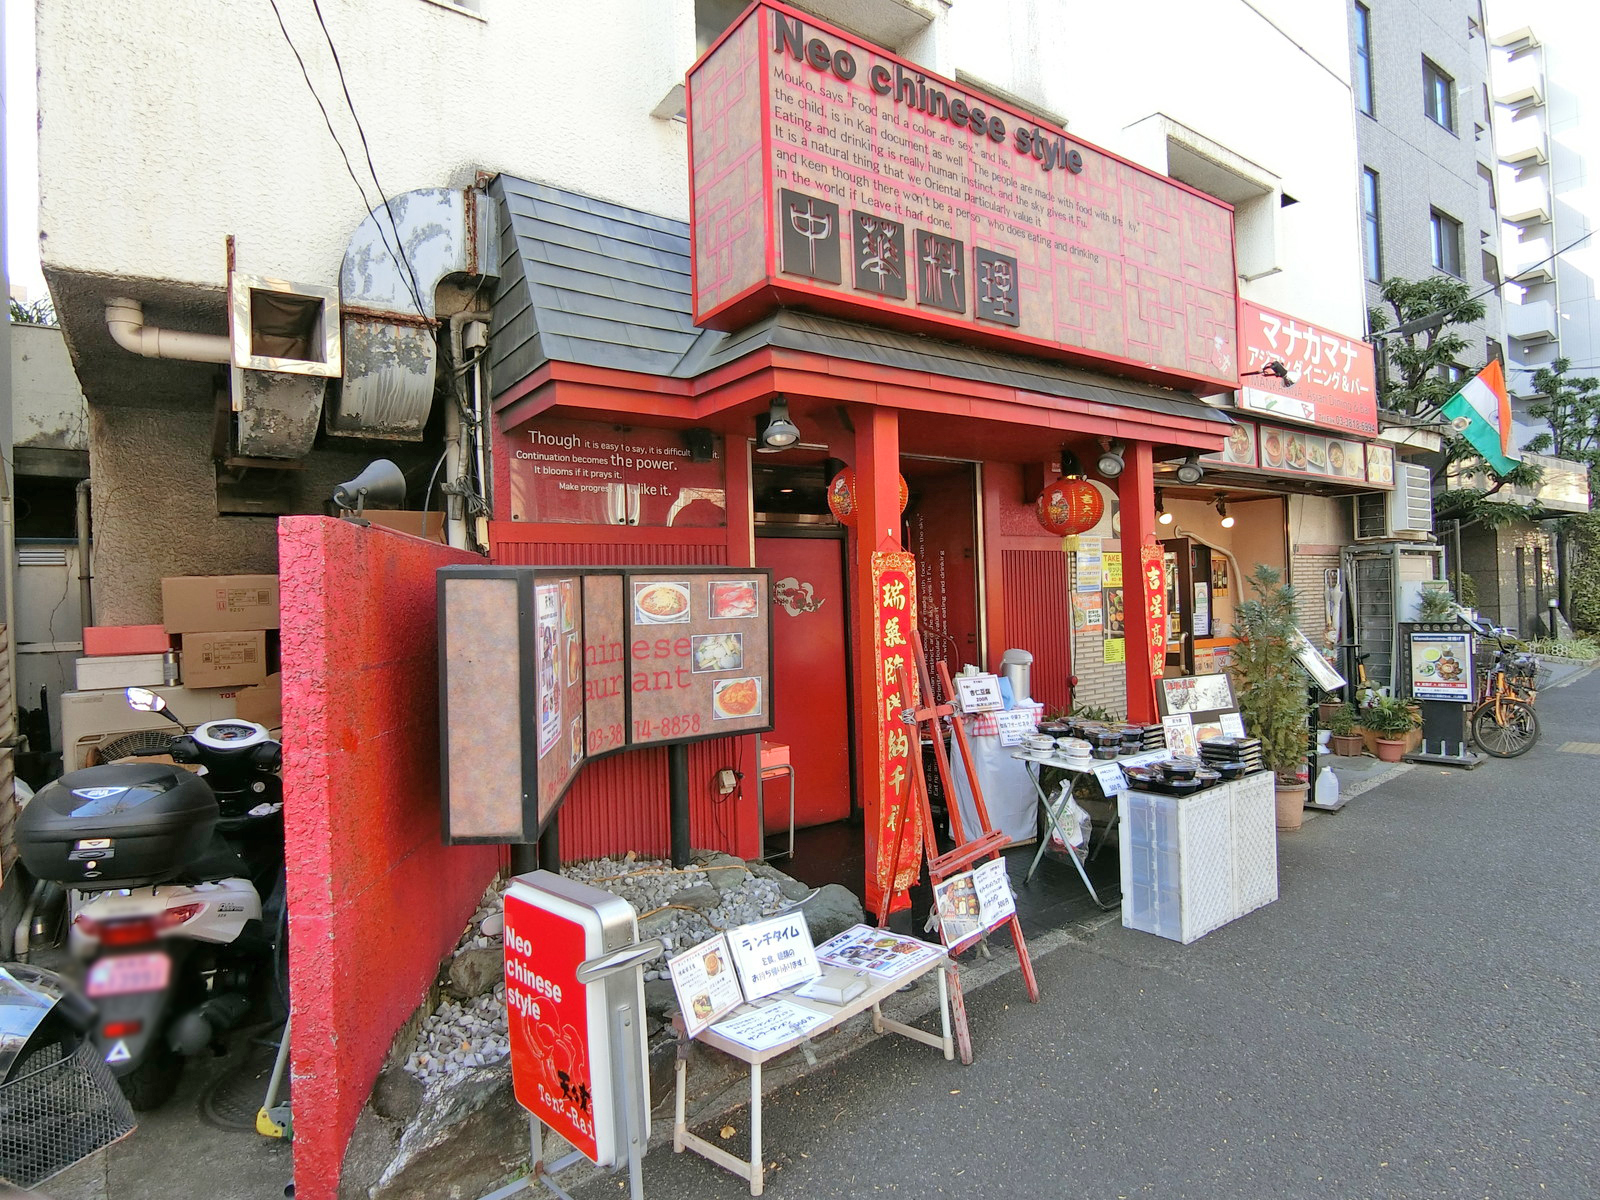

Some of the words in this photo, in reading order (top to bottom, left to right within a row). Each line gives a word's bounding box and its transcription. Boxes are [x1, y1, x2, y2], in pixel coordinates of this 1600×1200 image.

[772, 10, 857, 81] Neo
[867, 63, 1007, 143] chinese
[1013, 127, 1083, 175] style
[773, 66, 816, 94] Mouko,
[819, 86, 844, 104] says
[881, 110, 900, 126] and
[903, 119, 910, 129] a
[912, 122, 937, 139] color
[940, 133, 955, 146] are
[981, 149, 996, 163] and
[774, 106, 812, 132] Eating
[816, 123, 837, 139] and
[840, 130, 884, 157] drinking
[887, 147, 896, 160] is
[899, 153, 925, 171] really
[928, 162, 958, 180] human
[961, 172, 996, 196] instinct,
[998, 190, 1013, 202] and
[1015, 194, 1029, 206] the
[1031, 200, 1045, 214] sky
[1047, 207, 1067, 221] gives
[1068, 213, 1075, 225] it
[775, 88, 794, 105] the
[797, 98, 827, 119] child,
[831, 109, 840, 122] is
[843, 113, 854, 127] in
[857, 118, 877, 136] Kan
[880, 128, 929, 155] document
[932, 149, 943, 160] as
[945, 153, 963, 167] well
[991, 171, 1018, 189] people
[1020, 183, 1033, 194] are
[1035, 188, 1056, 203] made
[1057, 195, 1074, 210] with
[1076, 201, 1093, 216] food
[1094, 209, 1110, 223] with
[775, 124, 783, 138] It
[787, 129, 797, 143] is
[801, 136, 808, 146] a
[811, 139, 849, 161] natural
[853, 152, 880, 175] thing
[883, 163, 905, 181] that
[907, 173, 922, 185] we
[924, 177, 961, 199] Oriental
[964, 192, 1011, 218] particularly
[1013, 209, 1033, 225] value
[1035, 215, 1042, 227] it
[776, 165, 787, 179] in
[792, 171, 811, 186] the
[814, 180, 845, 197] world
[849, 187, 857, 200] if
[861, 191, 891, 211] Leave
[893, 202, 902, 215] it
[927, 213, 953, 230] done.
[776, 149, 797, 164] and
[801, 154, 828, 174] keen
[831, 165, 870, 188] though
[873, 179, 900, 196] there
[902, 190, 931, 207] won't
[932, 199, 945, 212] be
[947, 205, 953, 214] a
[987, 218, 1005, 232] who
[1006, 224, 1026, 239] does
[1027, 233, 1052, 249] eating
[1054, 240, 1068, 252] and
[1069, 245, 1099, 263] drinking
[1259, 312, 1358, 374] マナカマナ
[516, 450, 571, 462] Continuation
[572, 454, 608, 465] becomes
[610, 454, 633, 467] the
[636, 458, 678, 471] power.
[528, 430, 581, 449] Though
[584, 440, 590, 449] it
[592, 440, 599, 449] is
[600, 442, 619, 451] easy
[632, 445, 648, 455] say,
[648, 446, 655, 454] it
[655, 446, 663, 455] is
[666, 447, 691, 457] difficult
[534, 466, 542, 475] It
[543, 466, 573, 476] blooms
[575, 467, 582, 477] if
[582, 468, 589, 477] it
[590, 469, 612, 479] prays
[613, 469, 622, 479] it.
[559, 482, 579, 491] Make
[638, 482, 657, 496] like
[660, 484, 672, 496] it.
[1103, 554, 1120, 562] TAKE
[1146, 565, 1164, 677] 吉星高照
[505, 925, 533, 958] Neo
[742, 925, 800, 951] ランチタイム
[506, 957, 563, 1004] chinese
[507, 987, 542, 1021] style
